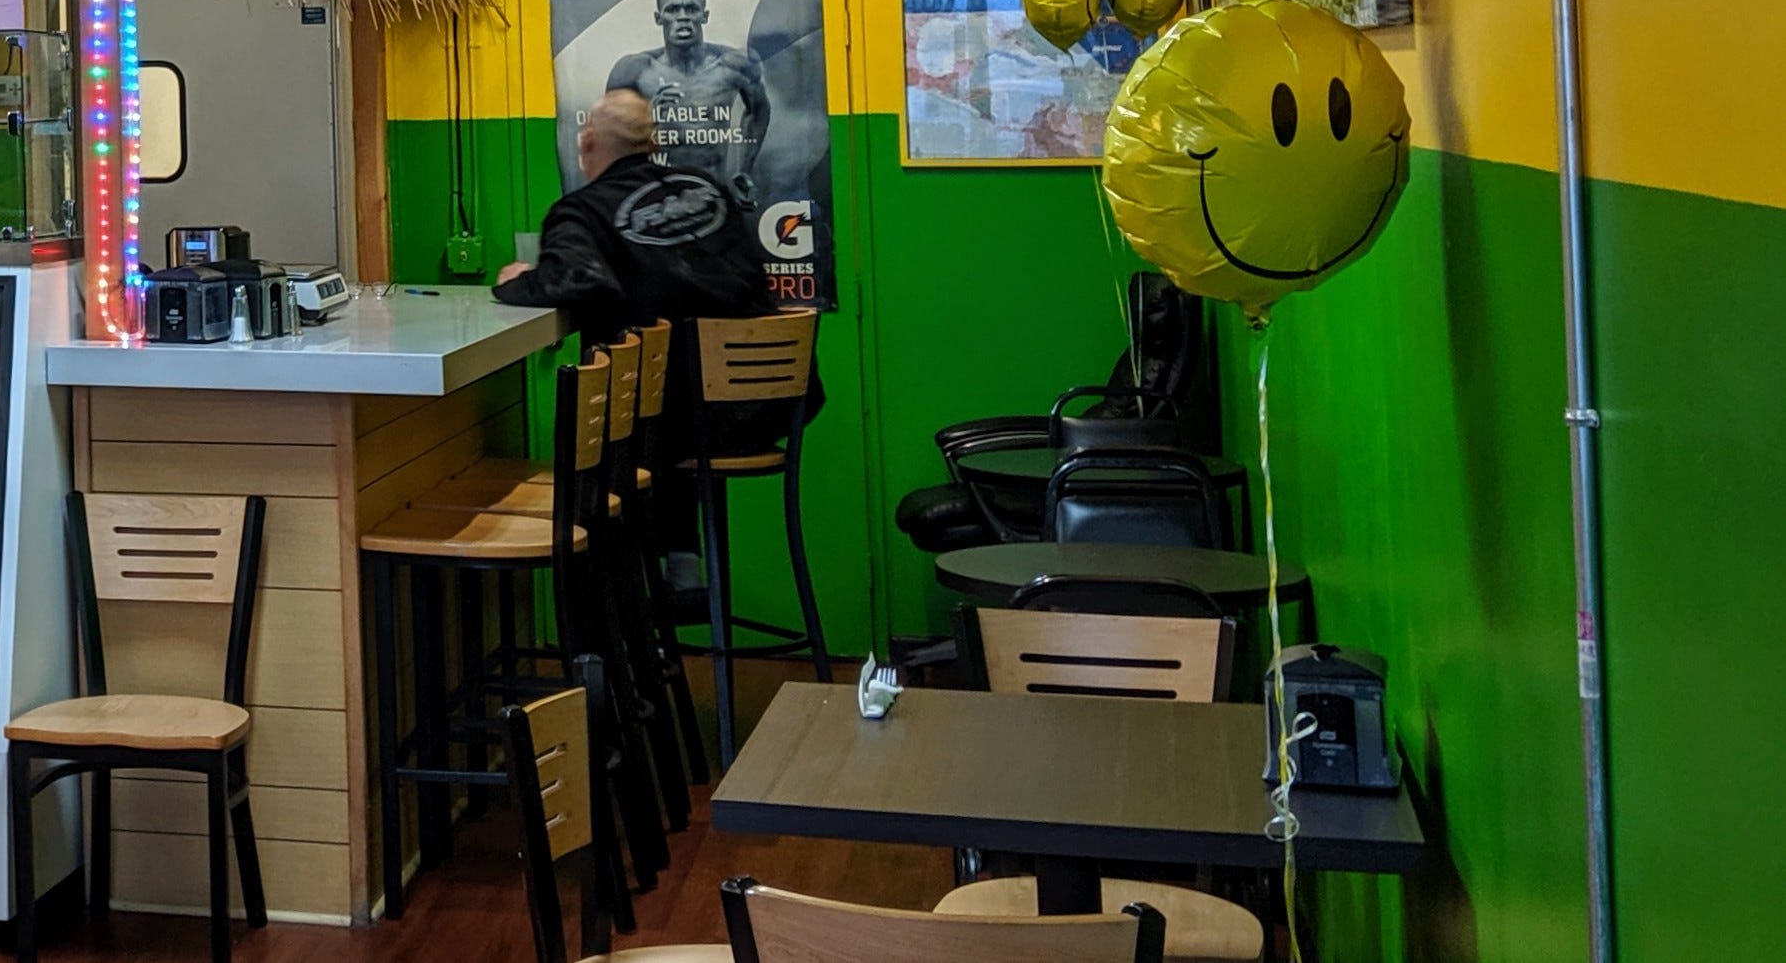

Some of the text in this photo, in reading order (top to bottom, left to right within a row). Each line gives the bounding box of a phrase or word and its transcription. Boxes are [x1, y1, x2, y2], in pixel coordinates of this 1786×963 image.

[652, 105, 731, 123] ILABLE IN
[685, 127, 758, 145] ROOMS...
[757, 199, 815, 260] G
[762, 262, 815, 275] SERIES
[766, 276, 816, 300] PRO
